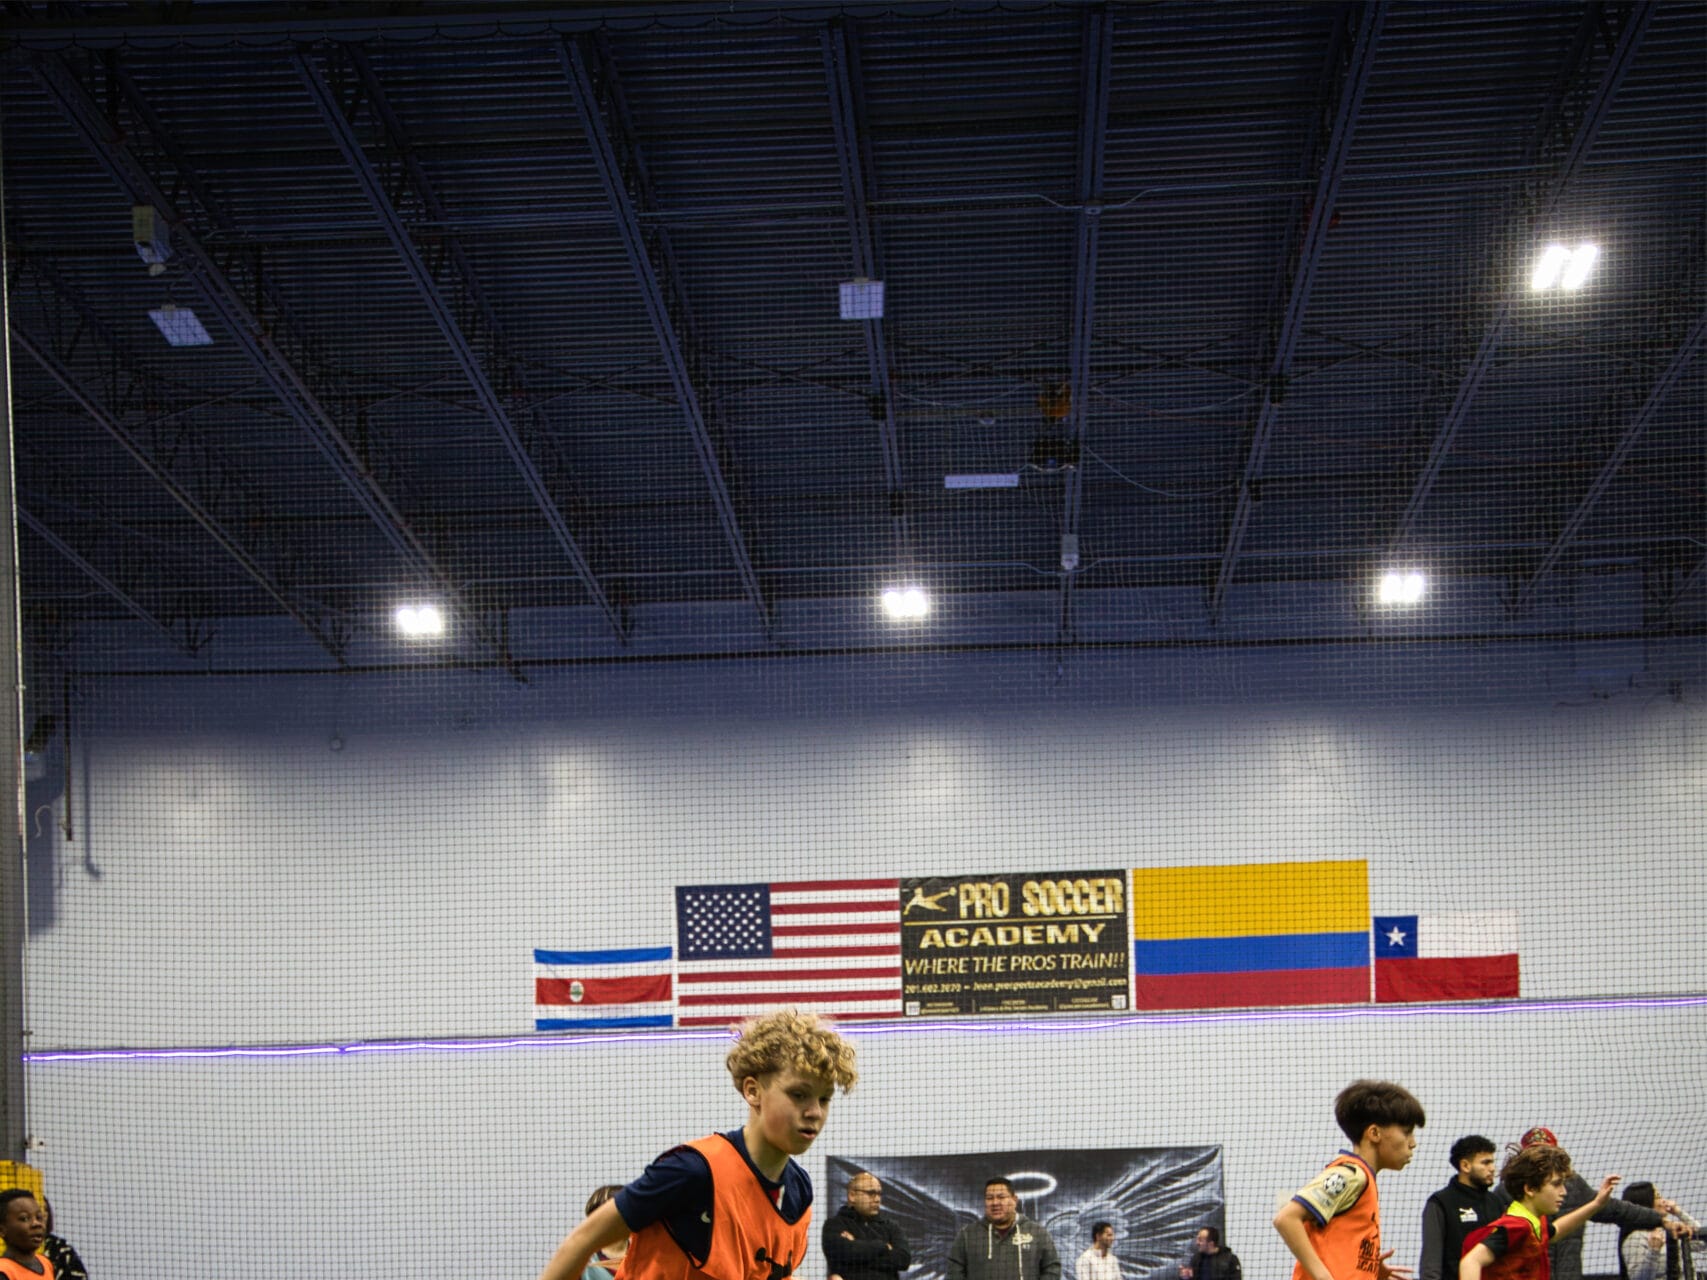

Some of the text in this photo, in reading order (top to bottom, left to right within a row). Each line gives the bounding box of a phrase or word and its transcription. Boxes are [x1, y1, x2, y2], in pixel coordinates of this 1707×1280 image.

[959, 878, 1125, 919] PRO SOCCER
[919, 922, 1106, 949] ACADEMY
[905, 951, 1125, 976] WHERE THE PROS TRAIN!!
